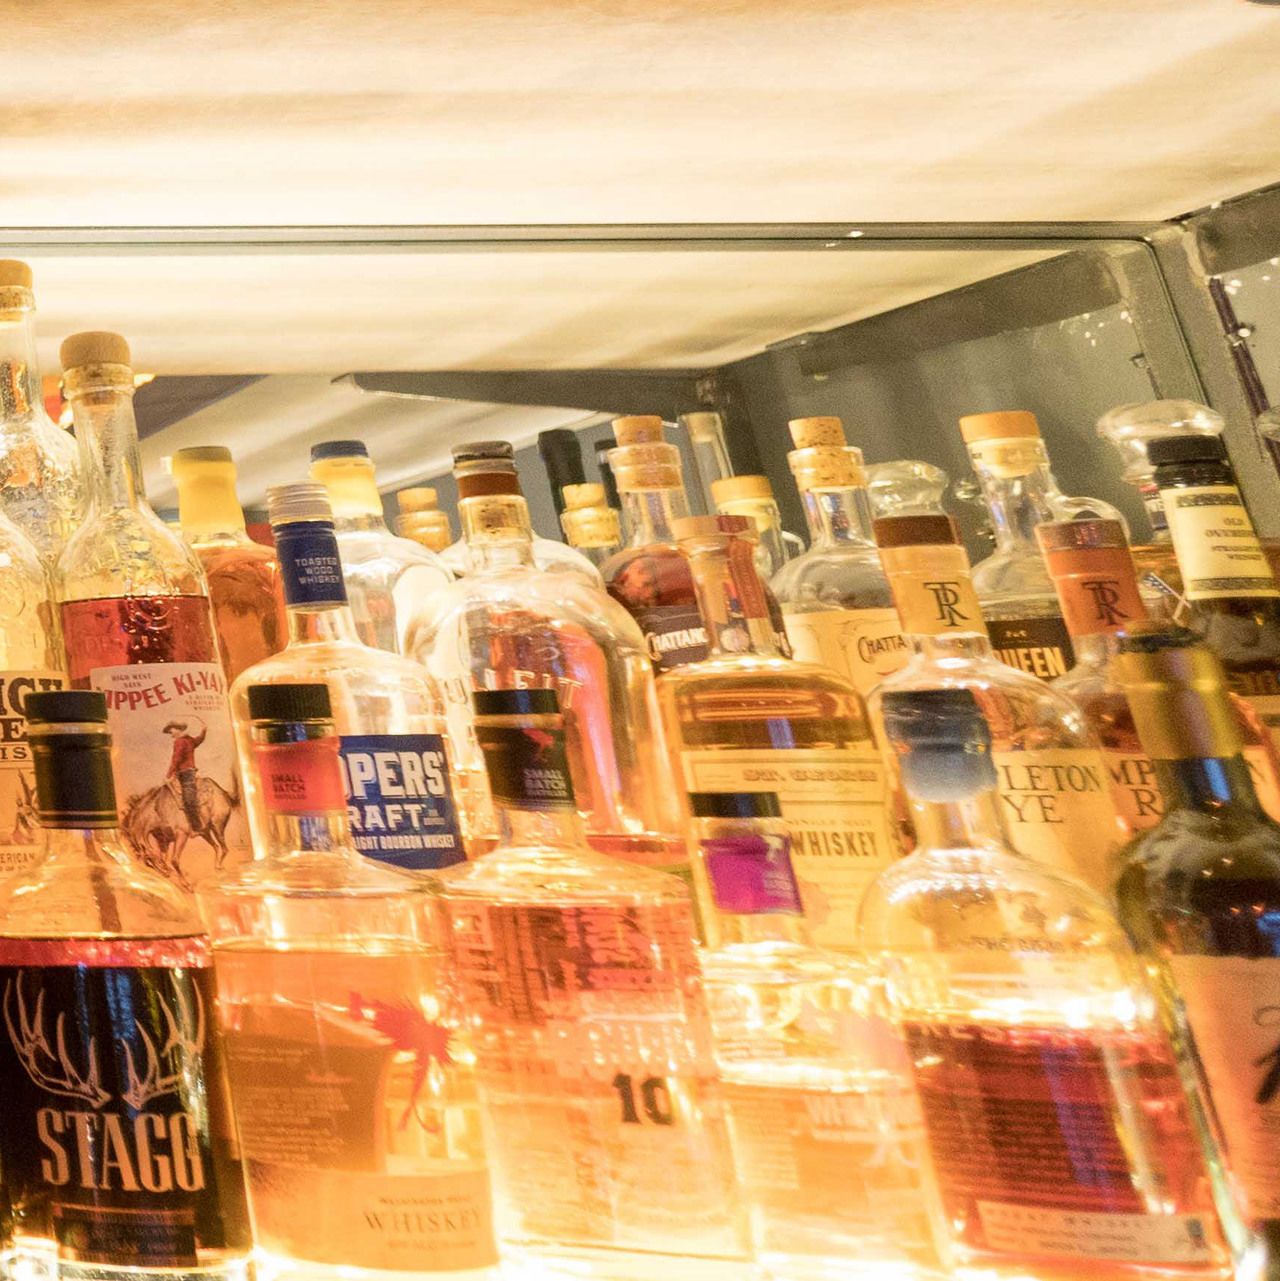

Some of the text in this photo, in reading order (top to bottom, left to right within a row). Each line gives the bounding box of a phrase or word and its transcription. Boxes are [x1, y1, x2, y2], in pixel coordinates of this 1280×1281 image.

[294, 556, 338, 567] TOASTED
[305, 566, 334, 576] WOOD
[299, 575, 340, 584] WHISKEY
[271, 775, 304, 784] SMALL
[525, 780, 566, 791] BATCH
[380, 834, 455, 850] BOURBON WHISKEY
[790, 831, 879, 856] WHISKEY
[612, 1072, 674, 1126] 10
[36, 1107, 206, 1194] STAGG
